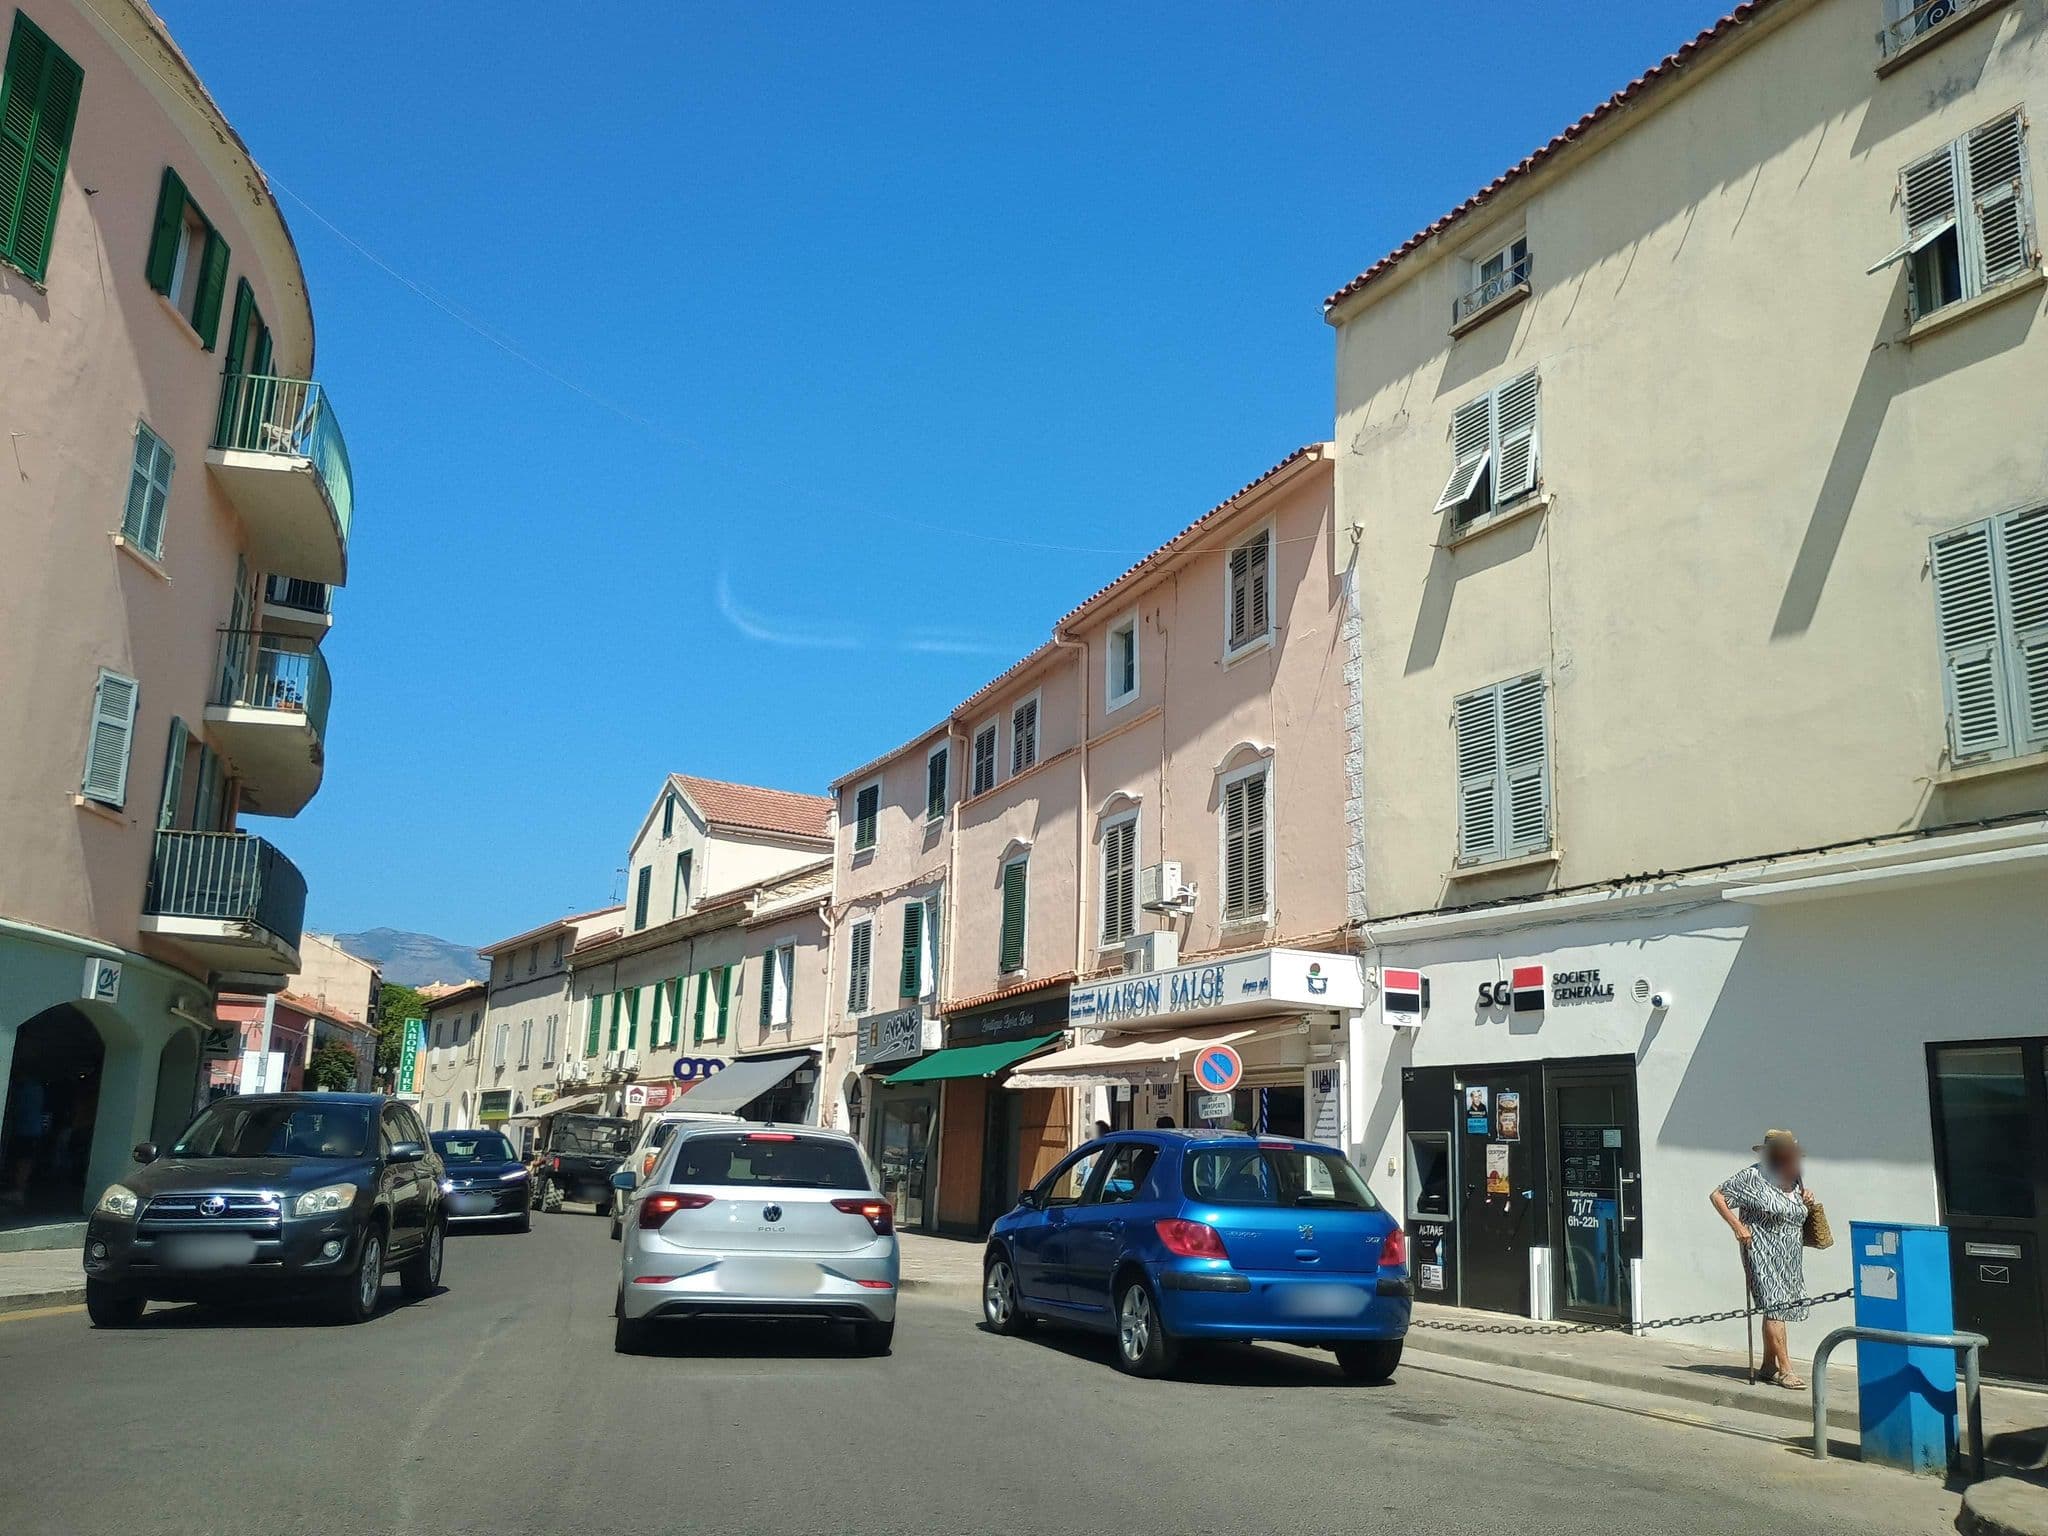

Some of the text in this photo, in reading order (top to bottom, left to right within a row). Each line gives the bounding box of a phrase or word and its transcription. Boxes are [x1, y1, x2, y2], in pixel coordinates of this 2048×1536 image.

[1552, 969, 1601, 985] SOCIETE
[1097, 978, 1160, 1015] MAISON
[1478, 980, 1511, 1008] SG
[1553, 984, 1614, 1000] GENERALE
[883, 1008, 920, 1043] AVENUE
[402, 1020, 419, 1091] LABORATOIRE
[1566, 1190, 1598, 1198] Libre-Service
[1571, 1199, 1594, 1216] 7j/7
[1567, 1216, 1599, 1228] 6h-22h
